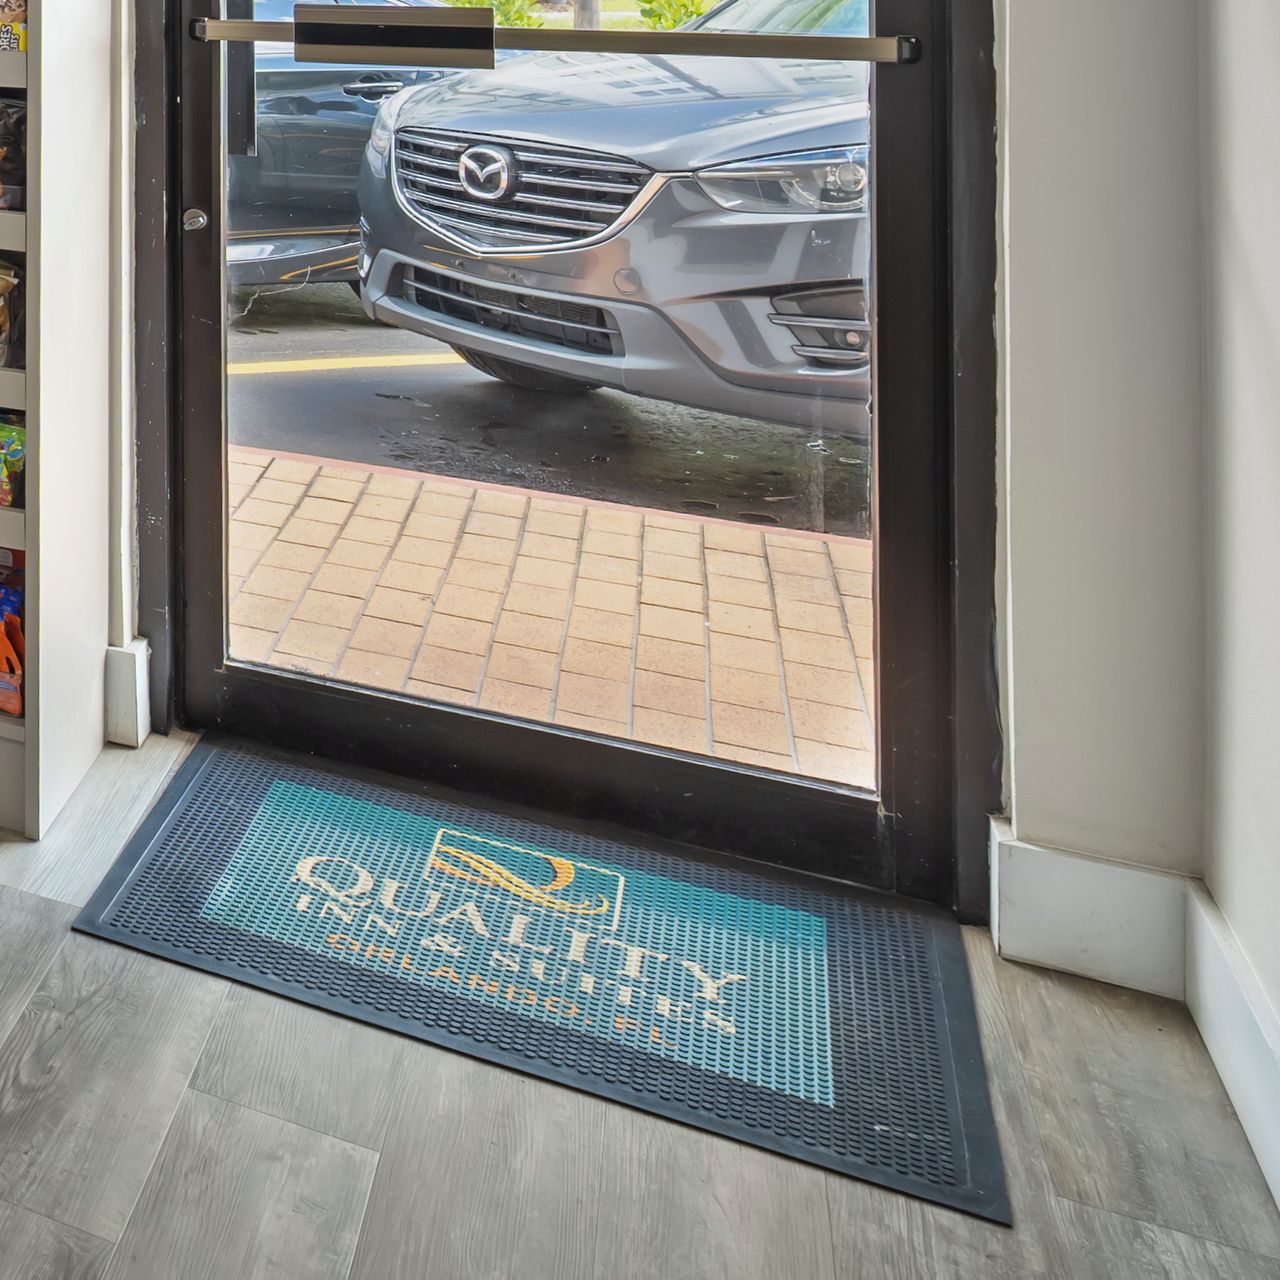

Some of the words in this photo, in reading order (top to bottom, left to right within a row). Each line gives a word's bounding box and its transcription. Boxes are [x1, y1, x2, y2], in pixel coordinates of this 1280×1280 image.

[293, 856, 746, 1004] QUALITY
[296, 895, 402, 937] INN
[421, 933, 464, 958] &
[490, 950, 736, 1034] SUITES
[615, 1016, 678, 1049] FL
